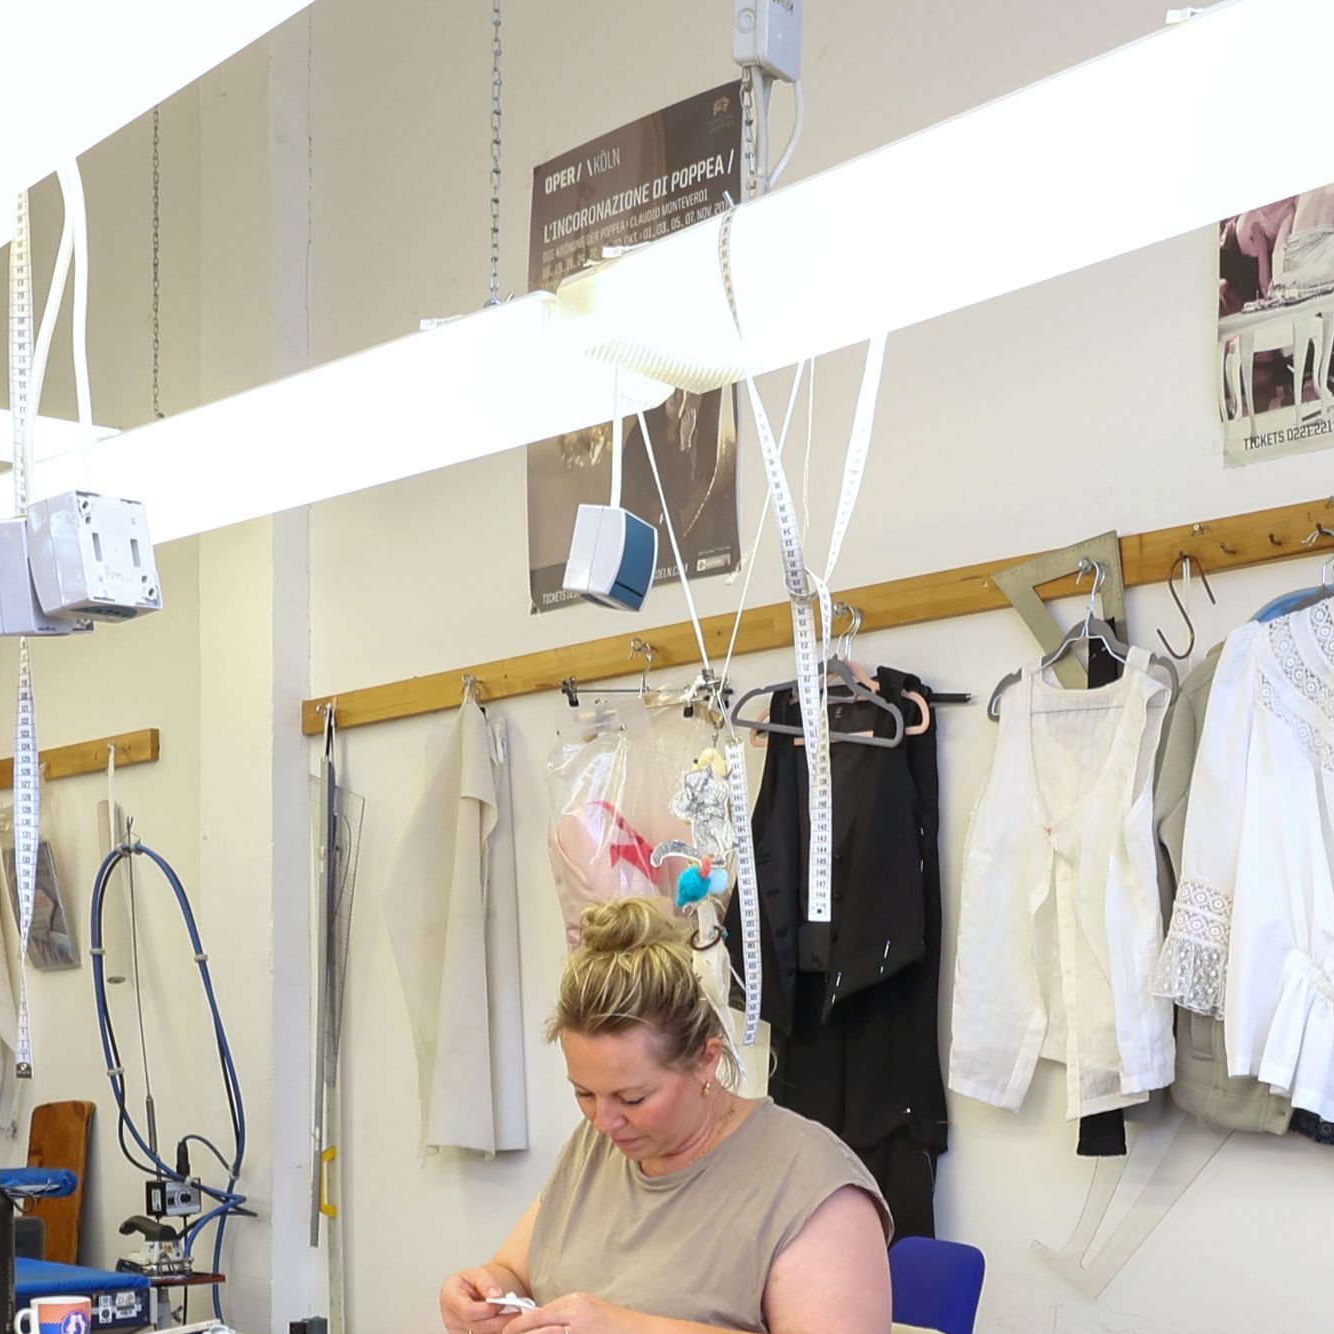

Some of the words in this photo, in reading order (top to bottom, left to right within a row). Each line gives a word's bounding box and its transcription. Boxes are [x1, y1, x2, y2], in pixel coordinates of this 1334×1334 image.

[543, 183, 650, 244] L'INCORONAZIONE
[653, 175, 668, 199] DI
[671, 155, 724, 193] POPPEA
[630, 208, 660, 228] CLAUDIO
[661, 188, 708, 216] MONTEVERDI
[1243, 430, 1286, 451] TICKETS
[542, 590, 567, 605] TICKETS
[819, 777, 828, 785] 138
[818, 789, 828, 797] 139
[817, 811, 827, 819] 141
[817, 823, 827, 831] 142
[817, 834, 827, 843] 143
[817, 846, 827, 854] 144
[816, 857, 827, 865] 145
[816, 868, 827, 877] 146
[816, 880, 827, 888] 147
